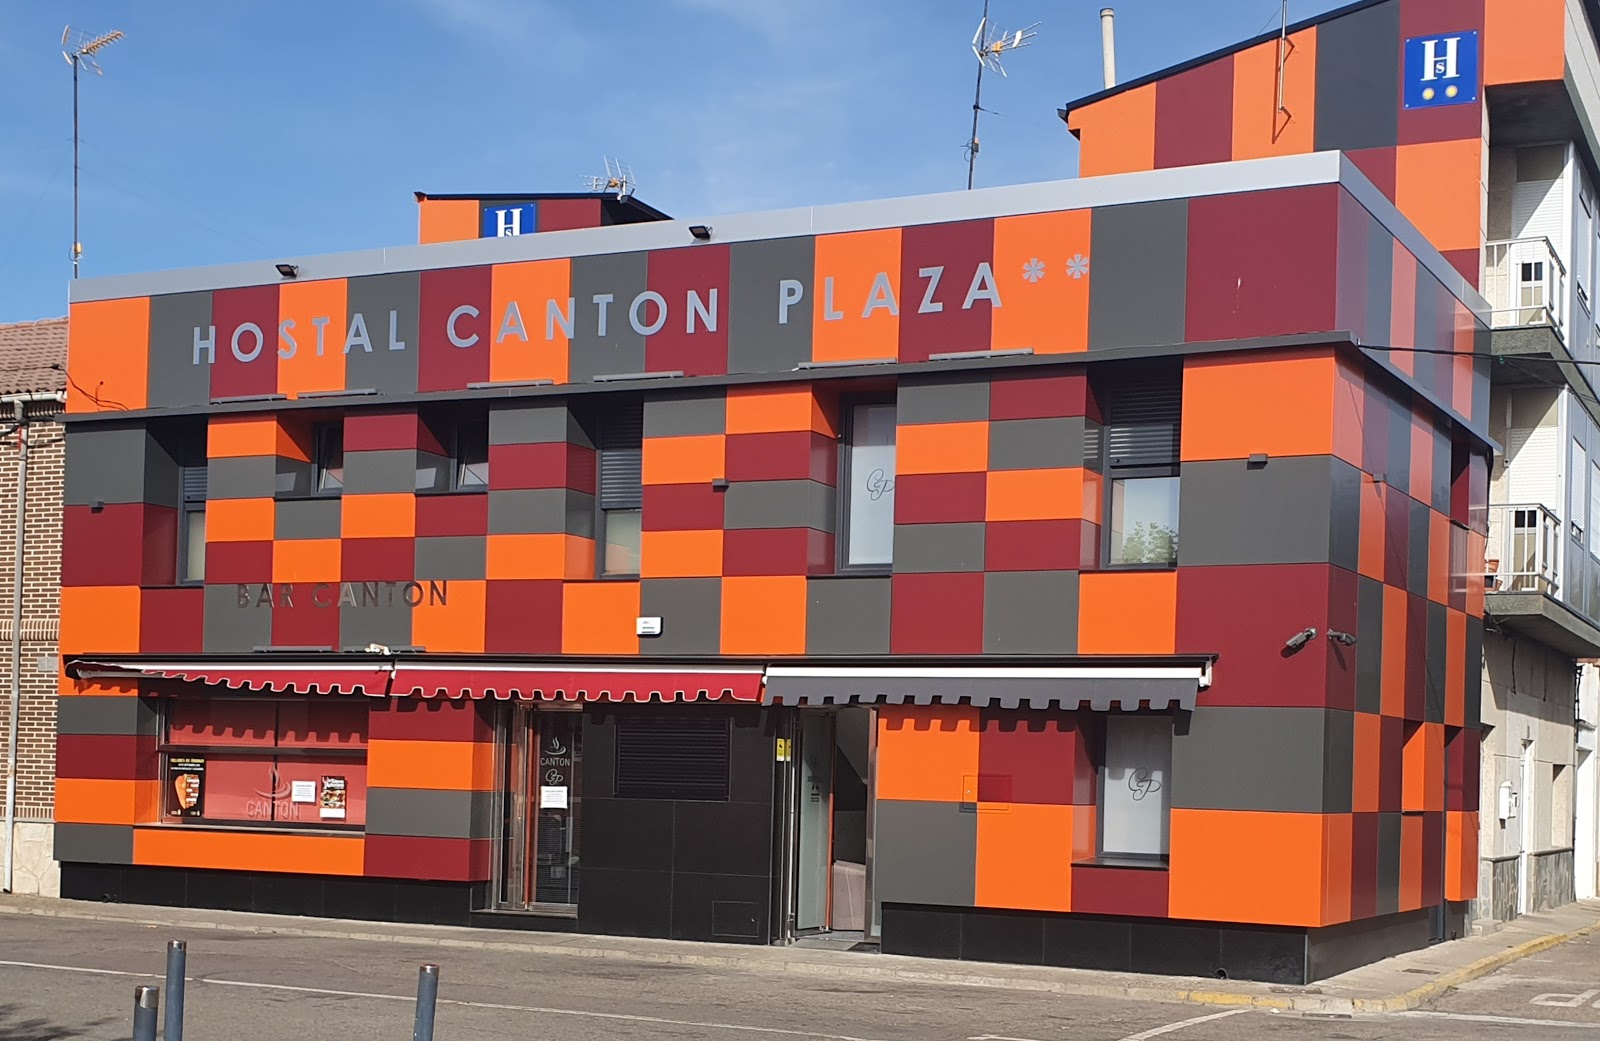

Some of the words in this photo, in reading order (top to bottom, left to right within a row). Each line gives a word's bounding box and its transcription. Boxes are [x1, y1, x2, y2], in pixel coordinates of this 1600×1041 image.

[193, 310, 405, 365] HOSTAL
[446, 288, 718, 349] CANTON
[236, 582, 294, 609] BAR
[311, 579, 448, 608] CANTON
[540, 757, 571, 767] CANTON
[246, 799, 300, 820] CANTON
